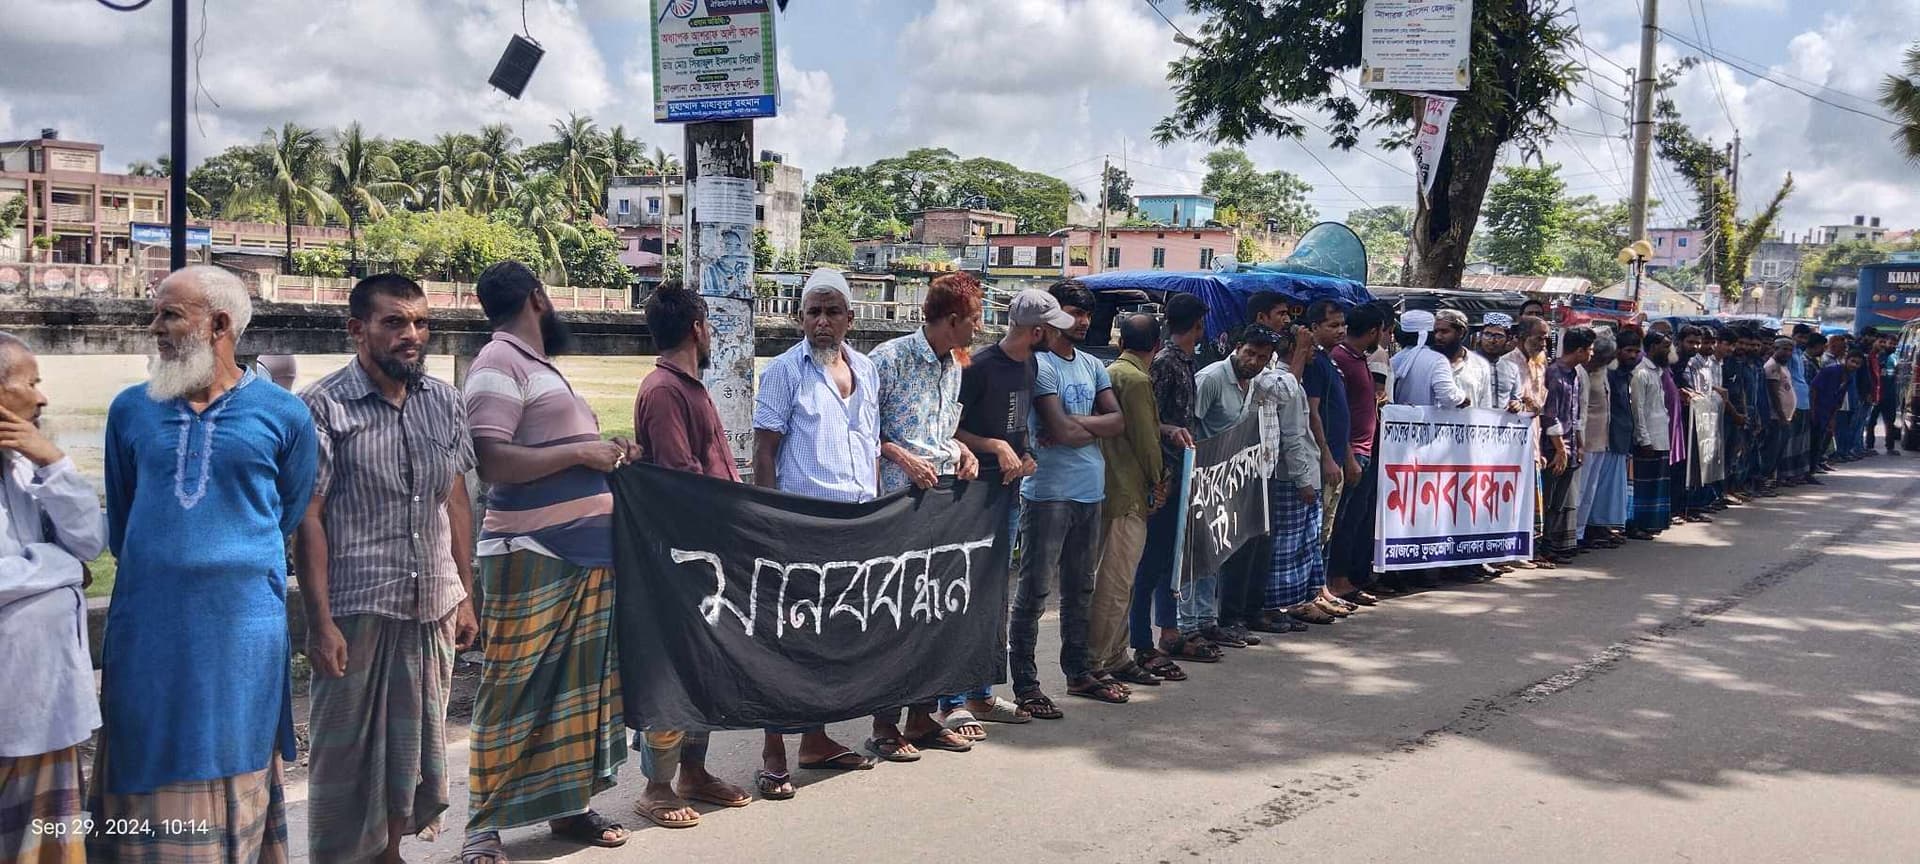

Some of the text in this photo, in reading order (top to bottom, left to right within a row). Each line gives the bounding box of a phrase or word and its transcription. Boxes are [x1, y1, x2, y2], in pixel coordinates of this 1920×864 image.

[1888, 272, 1920, 283] KHAN
[1385, 460, 1522, 527] মানববন্ধন
[1385, 544, 1420, 559] য়োজনেঃ
[1457, 540, 1484, 554] এলাকার
[670, 536, 995, 639] মানববন্ধন
